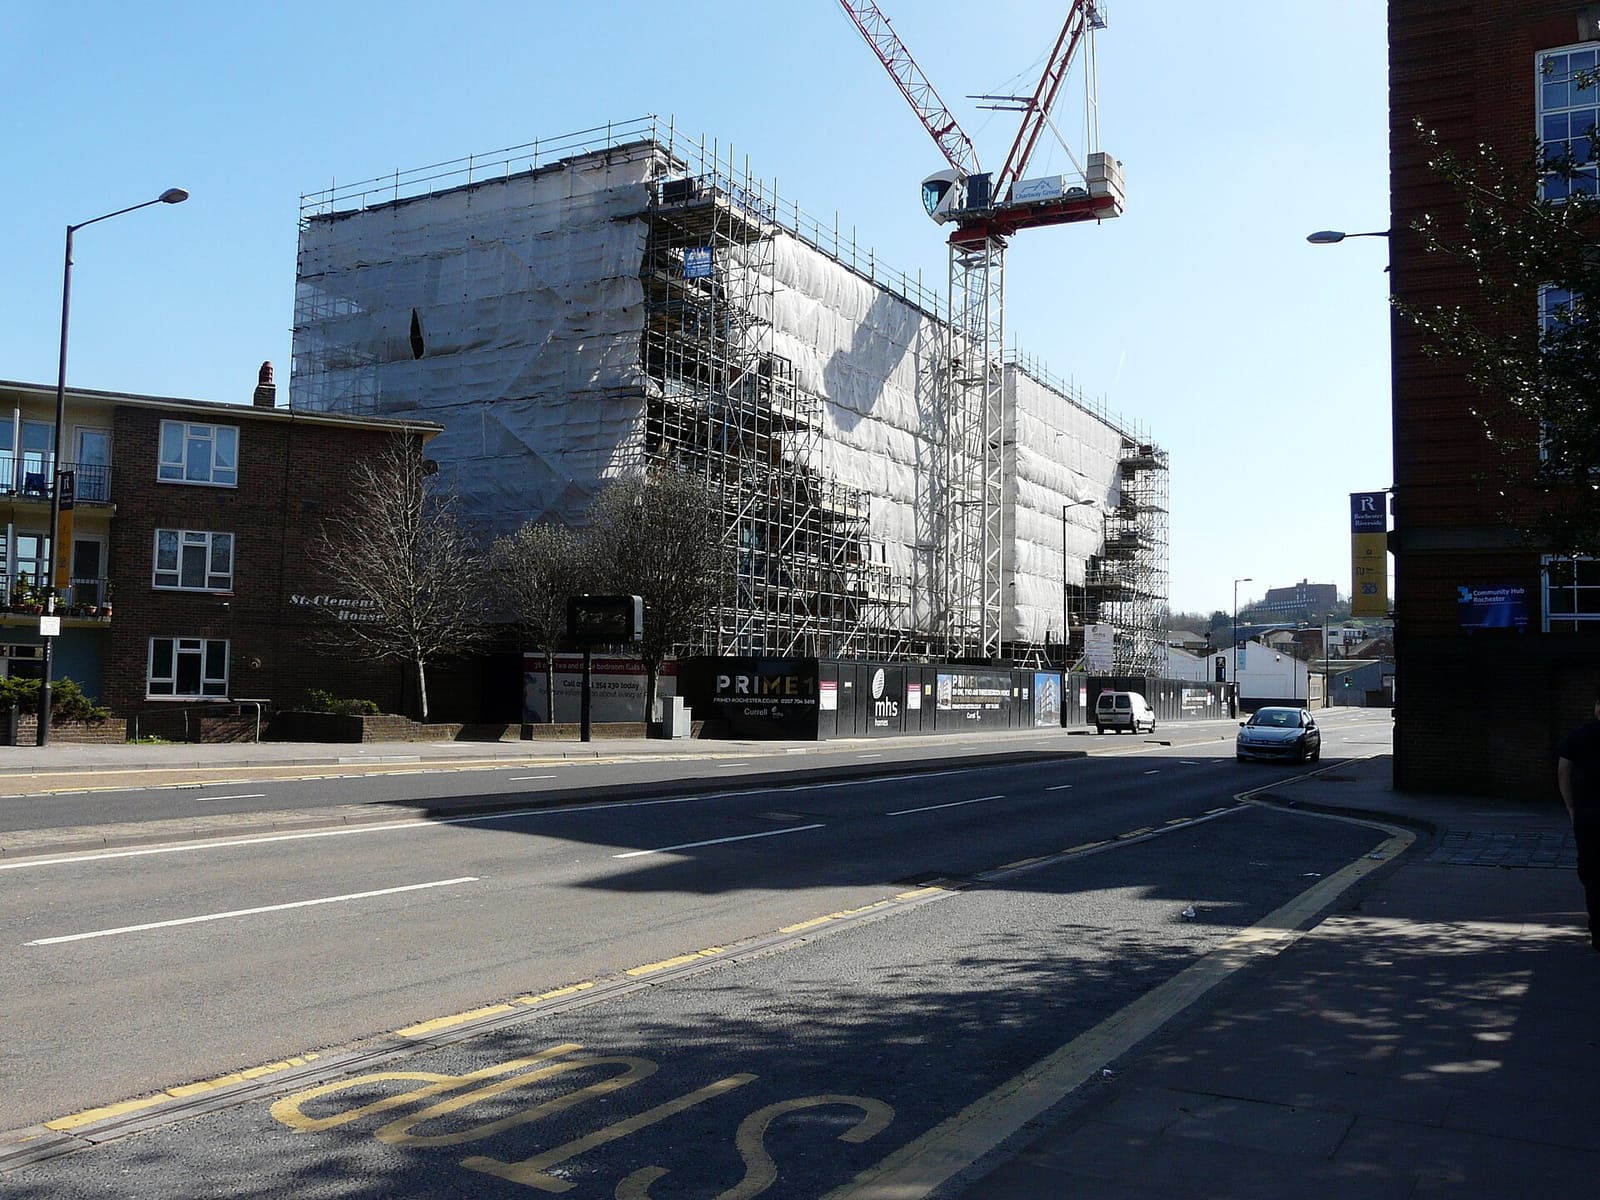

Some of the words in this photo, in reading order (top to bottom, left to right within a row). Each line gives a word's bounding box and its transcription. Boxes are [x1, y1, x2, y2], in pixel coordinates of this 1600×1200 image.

[1472, 588, 1510, 597] Community
[1510, 587, 1525, 595] Hub
[562, 680, 575, 688] Call
[620, 681, 640, 691] today
[874, 696, 898, 717] mhs
